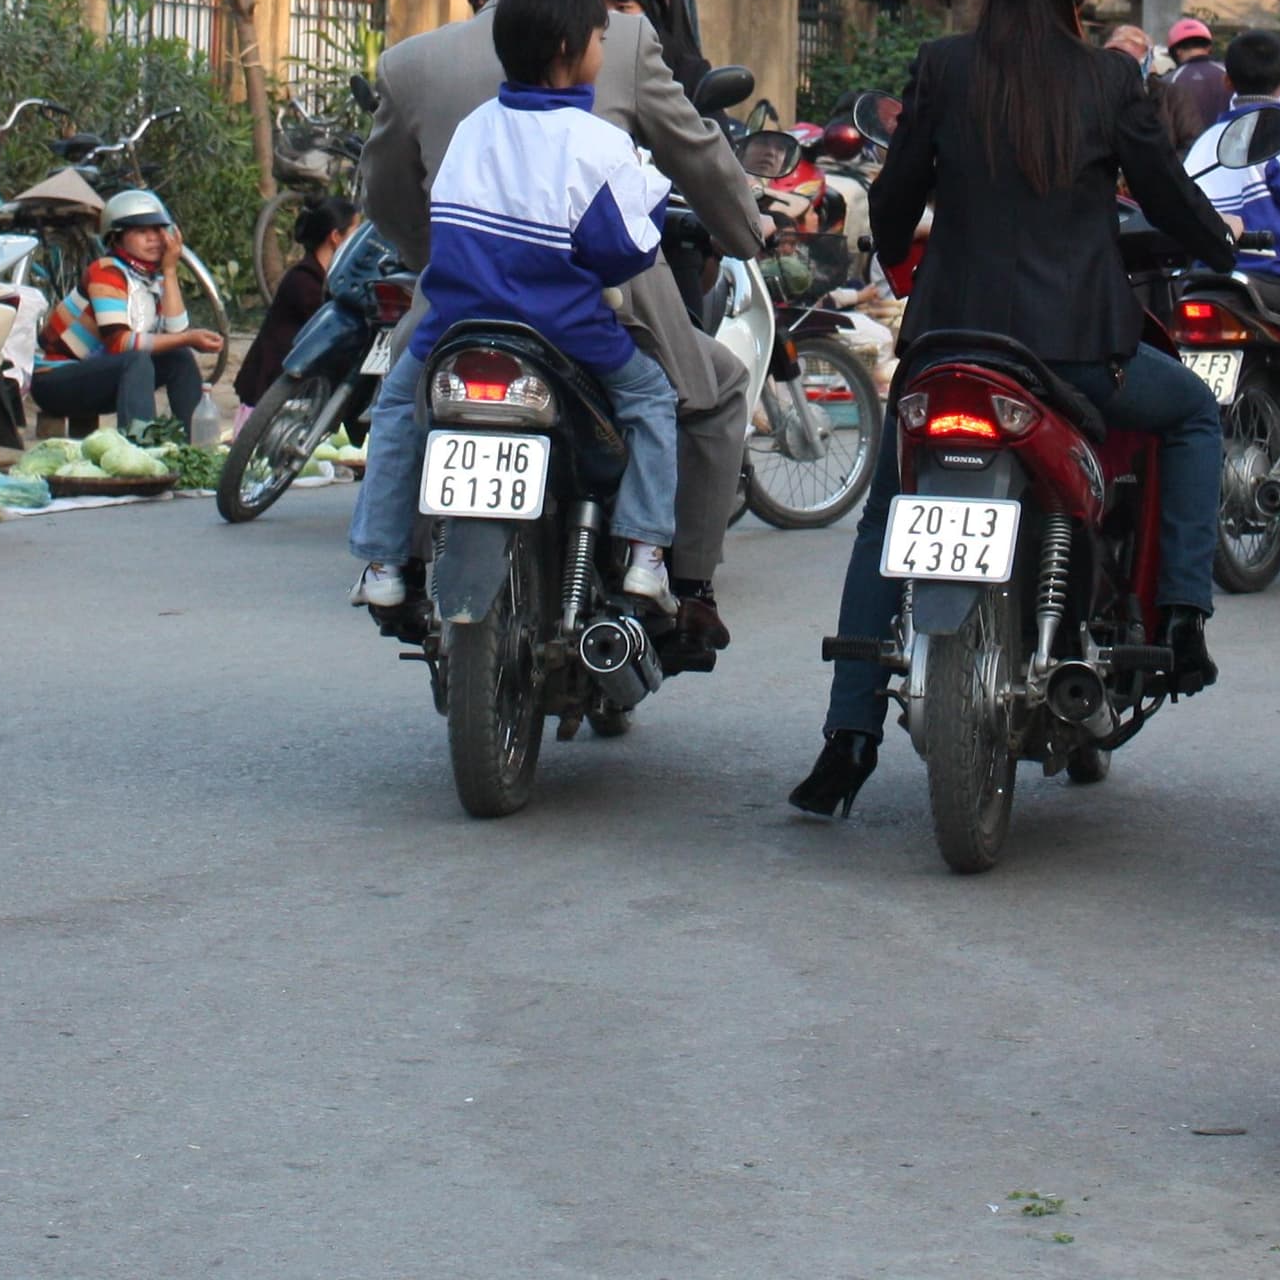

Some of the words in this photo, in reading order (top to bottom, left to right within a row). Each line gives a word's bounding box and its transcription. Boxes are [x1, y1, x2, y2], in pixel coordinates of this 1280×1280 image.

[442, 439, 531, 474] 20-H6
[943, 454, 984, 465] HONDA
[439, 475, 528, 511] 6138
[907, 504, 999, 539] 20-L3
[901, 540, 991, 576] 4384
